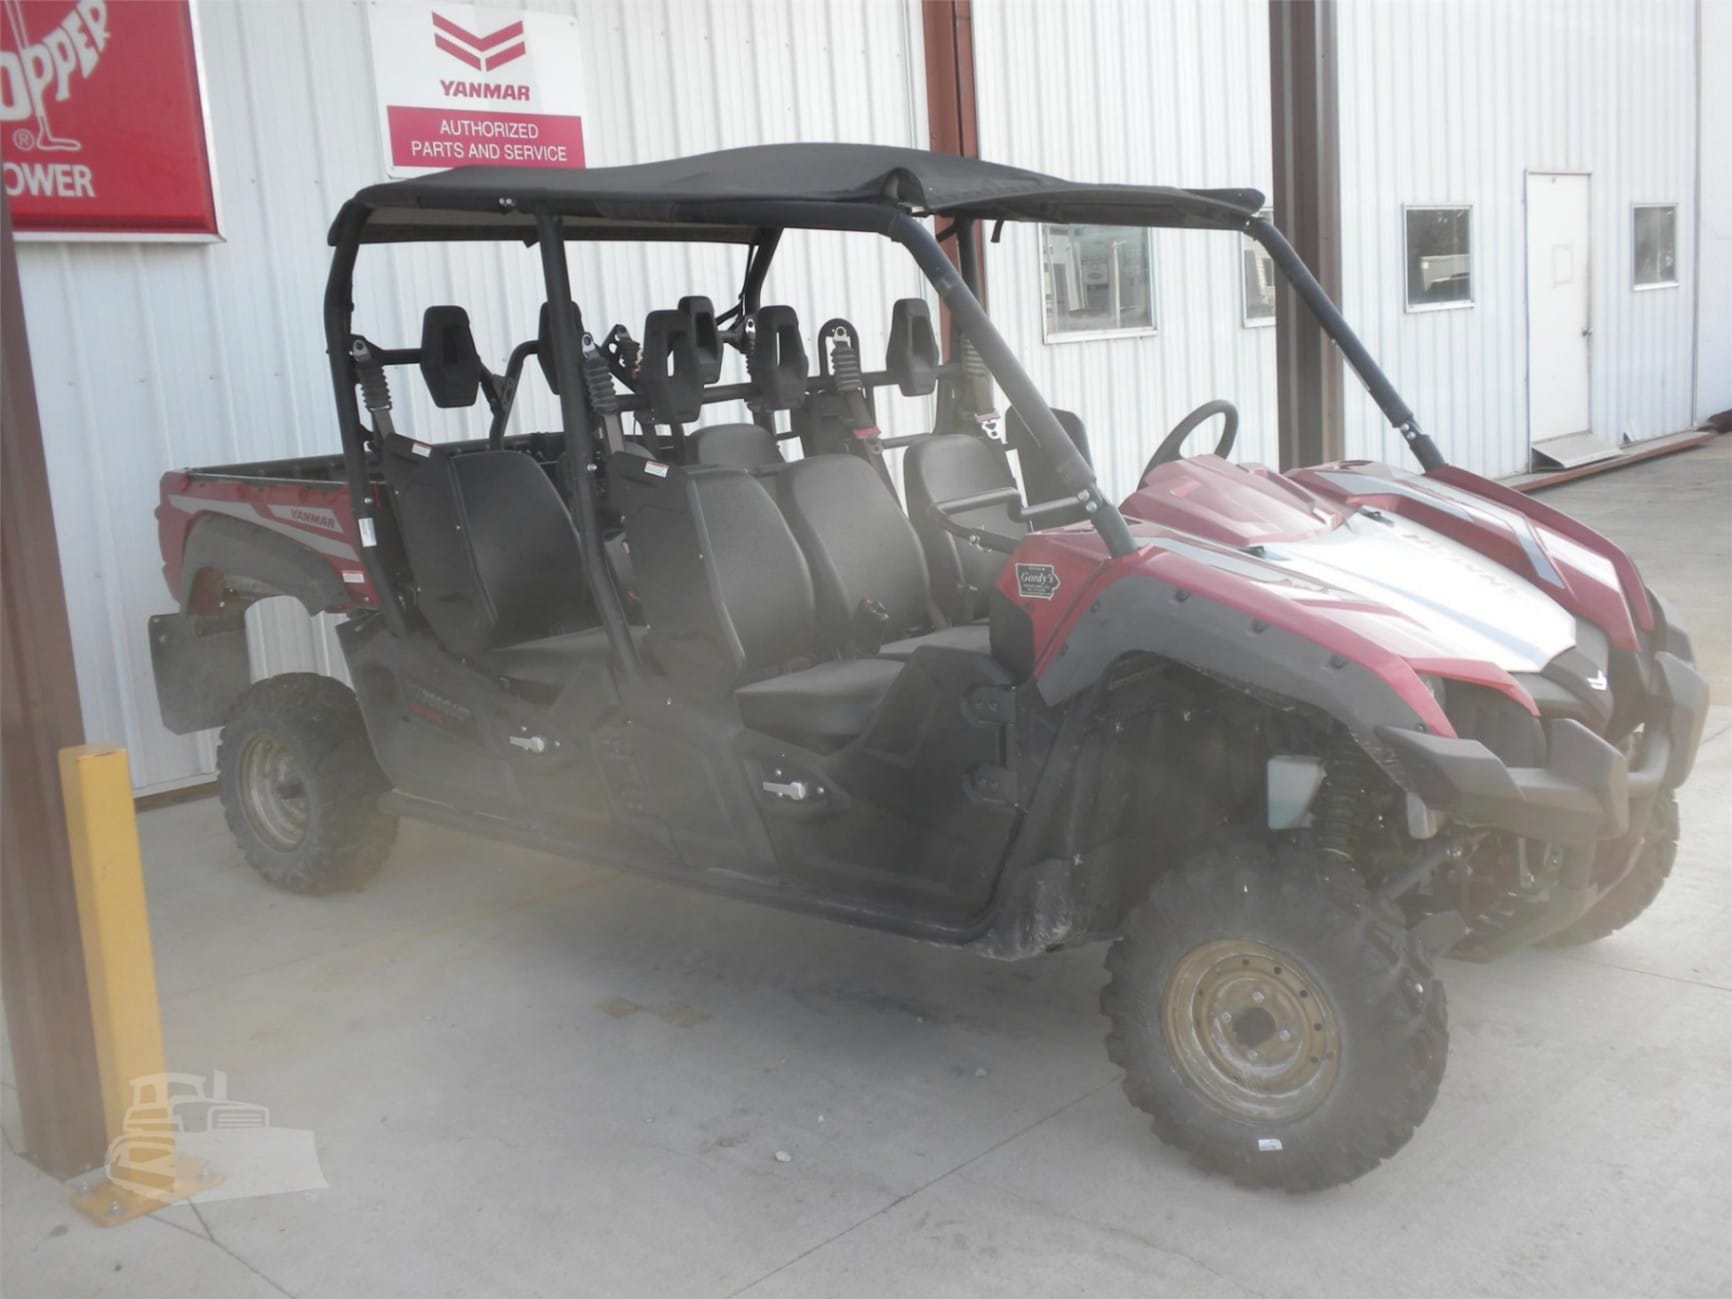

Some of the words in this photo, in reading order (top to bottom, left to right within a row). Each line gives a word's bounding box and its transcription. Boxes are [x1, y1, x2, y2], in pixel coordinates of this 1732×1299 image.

[0, 0, 110, 121] OPPER
[440, 80, 530, 101] YANMAR
[440, 120, 538, 139] AUTHORIZED
[411, 141, 464, 158] PARTS
[469, 144, 500, 159] AND
[504, 145, 568, 162] SERVICE
[2, 162, 96, 197] OWER
[290, 508, 335, 529] YANMAR
